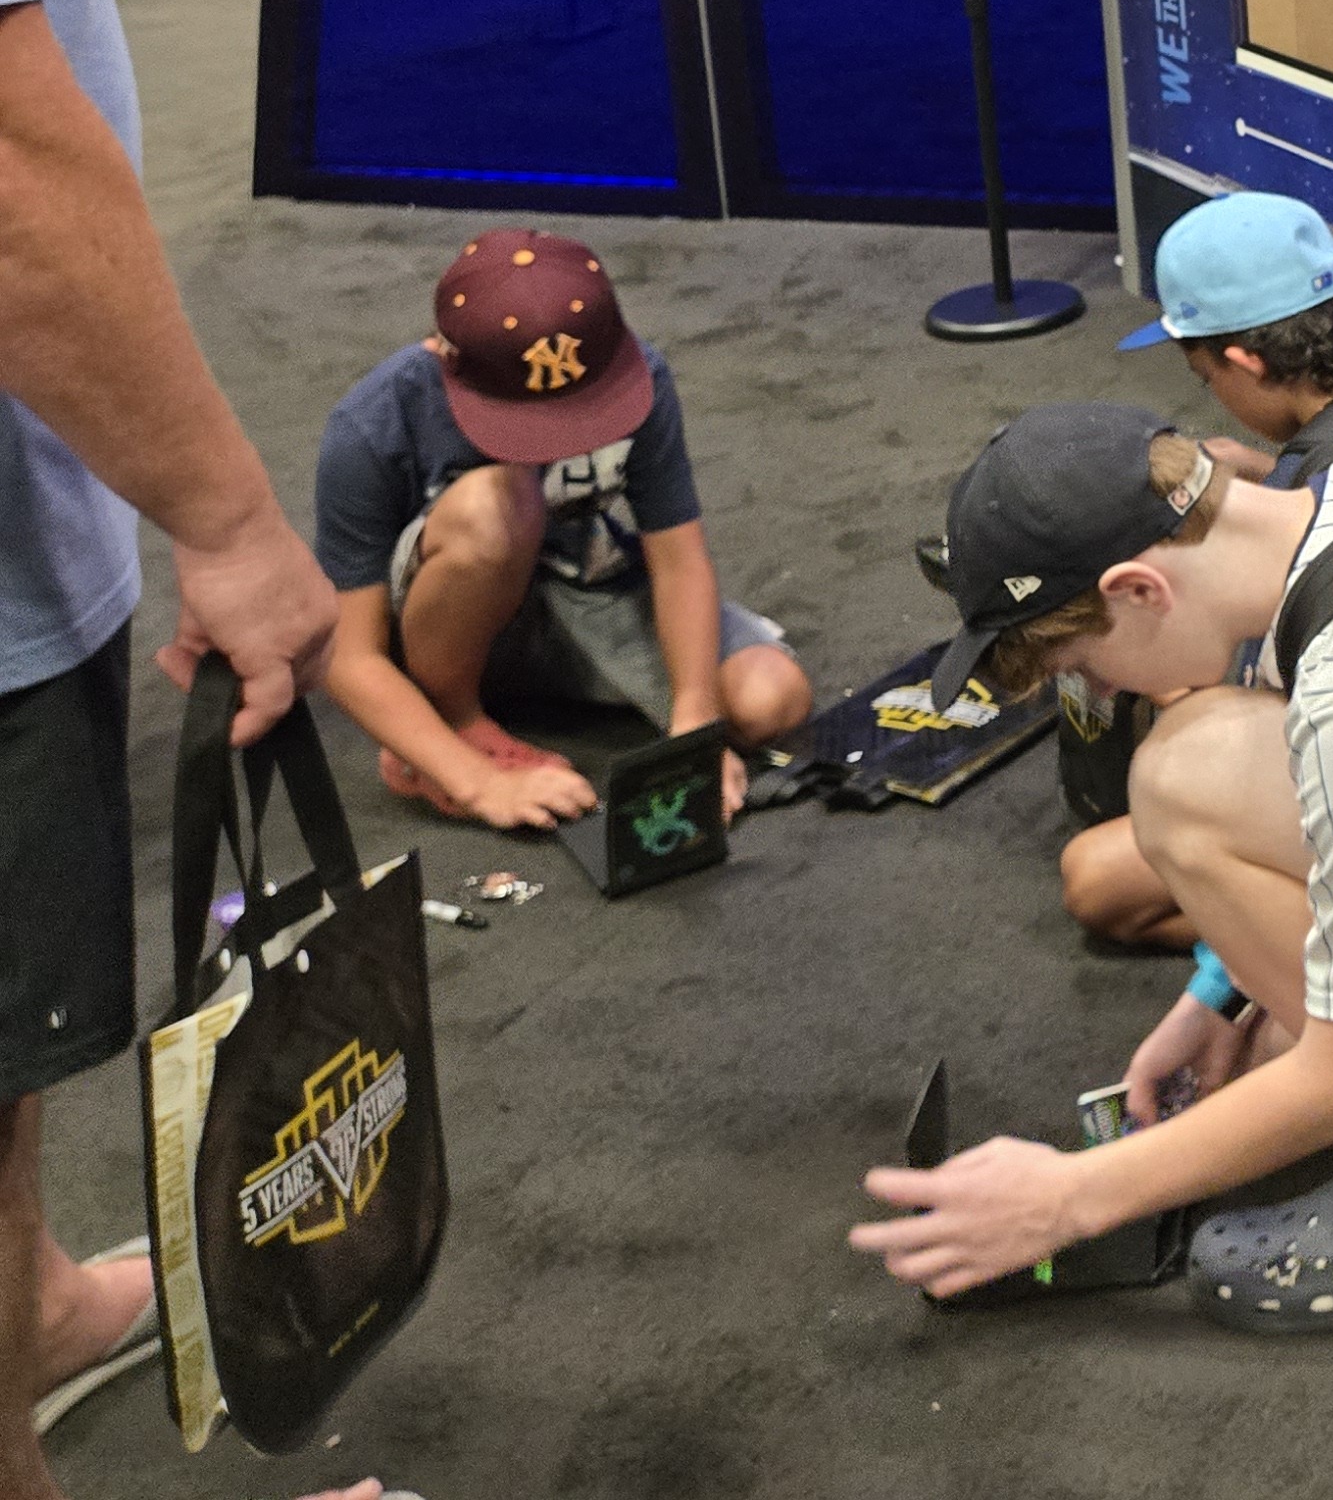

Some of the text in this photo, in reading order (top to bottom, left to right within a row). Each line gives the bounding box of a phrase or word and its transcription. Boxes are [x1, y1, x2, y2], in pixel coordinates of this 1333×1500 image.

[1157, 27, 1192, 105] WE
[240, 1153, 315, 1234] 5 YEARS
